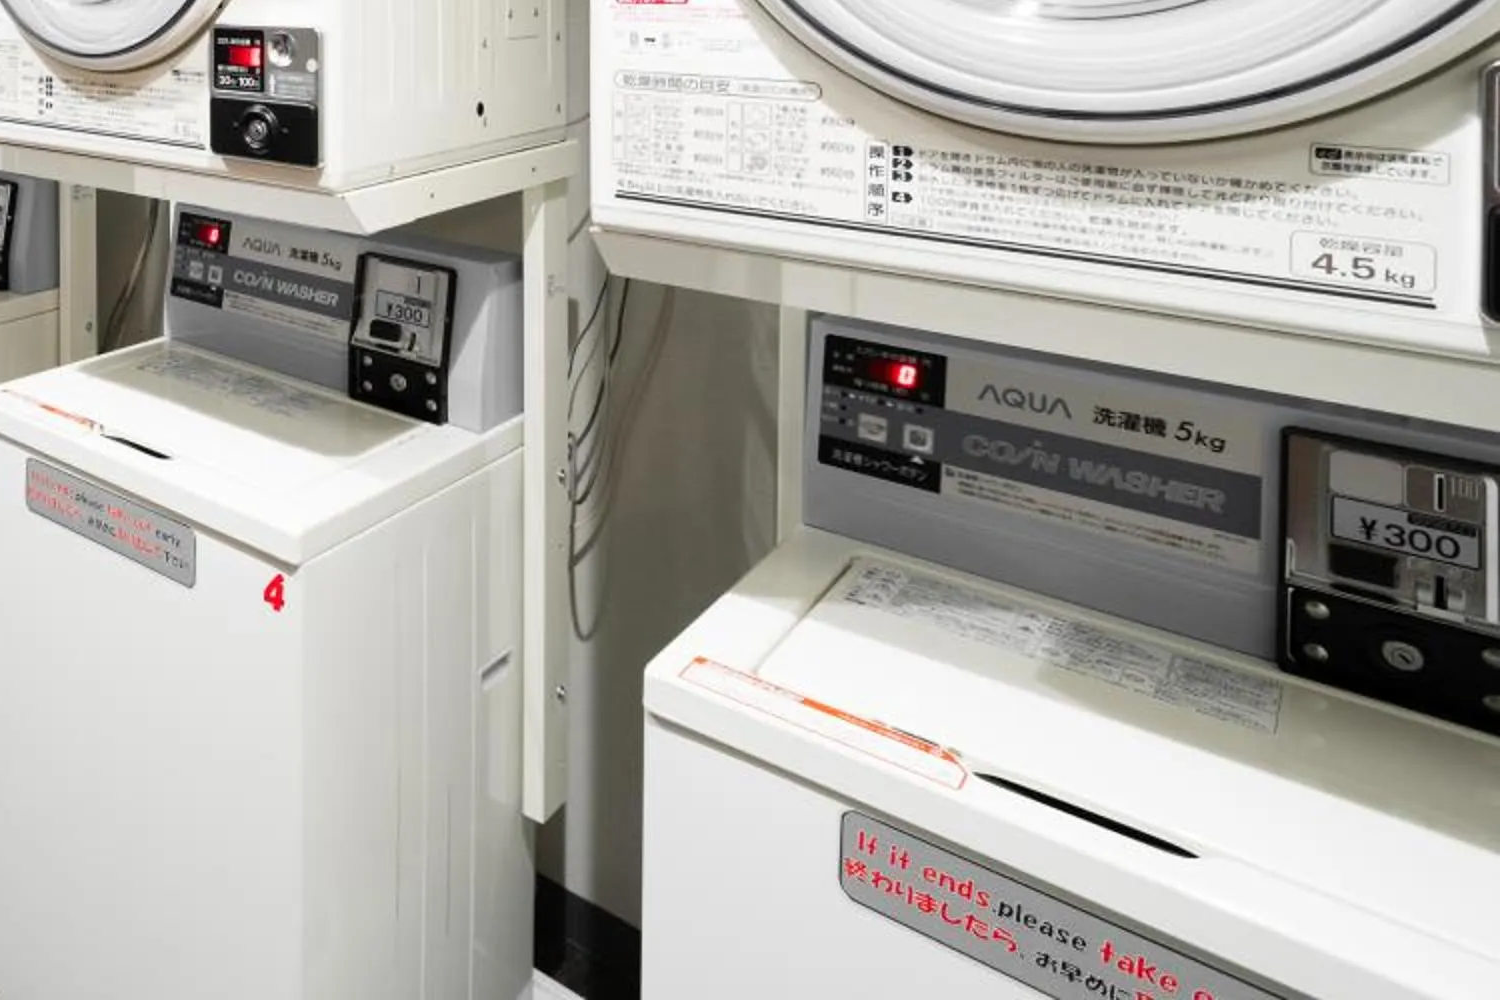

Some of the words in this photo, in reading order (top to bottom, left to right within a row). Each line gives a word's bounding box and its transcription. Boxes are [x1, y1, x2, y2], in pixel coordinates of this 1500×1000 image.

[242, 237, 282, 257] AQUA
[1311, 252, 1376, 280] 4.5
[1385, 268, 1416, 289] kg
[276, 281, 340, 307] WASHER
[978, 384, 1072, 419] AQUA
[1092, 404, 1167, 439] 洗濯機
[1174, 420, 1227, 453] 5kg
[1067, 457, 1227, 514] WASHER
[1359, 516, 1461, 560] ¥300
[263, 573, 285, 612] 4
[858, 831, 878, 855] If
[890, 846, 910, 870] it
[1100, 940, 1179, 993] take
